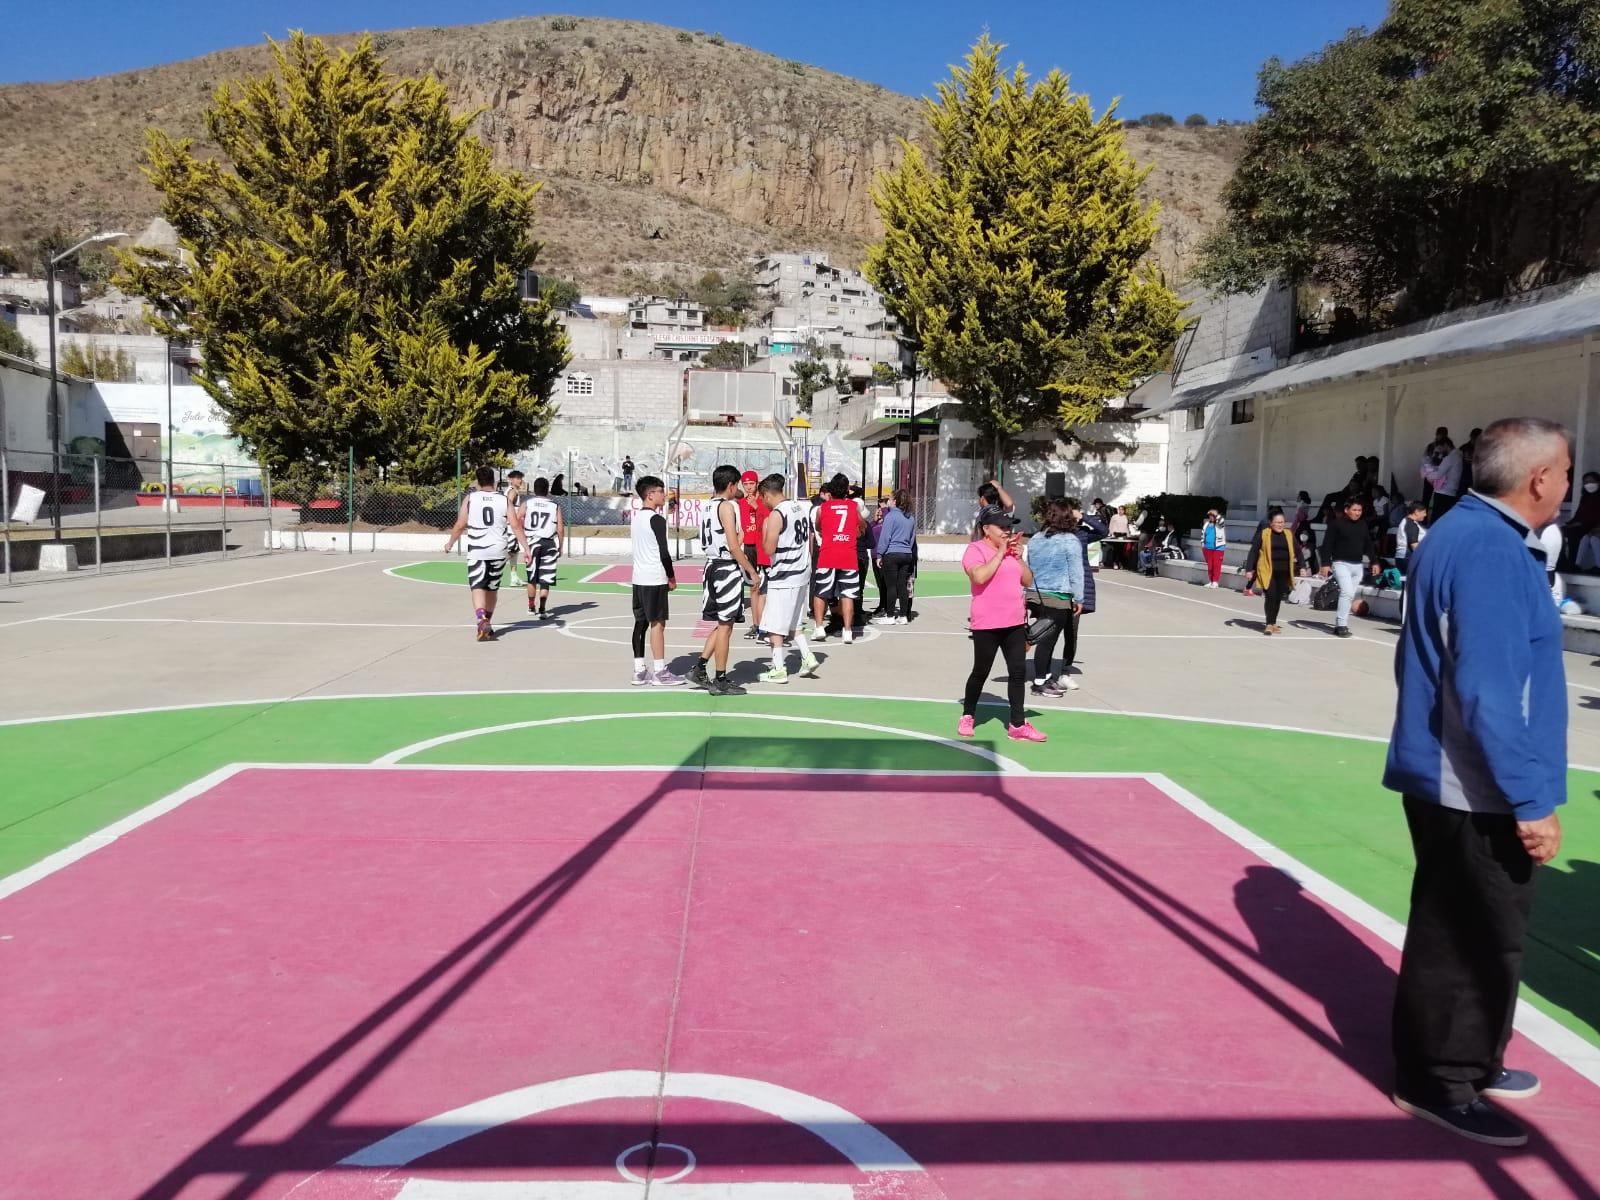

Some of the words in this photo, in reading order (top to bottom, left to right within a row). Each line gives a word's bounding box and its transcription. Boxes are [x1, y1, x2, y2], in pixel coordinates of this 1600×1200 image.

[482, 506, 495, 527] 0
[530, 511, 550, 529] 07
[835, 509, 848, 533] 7
[794, 516, 808, 545] 88
